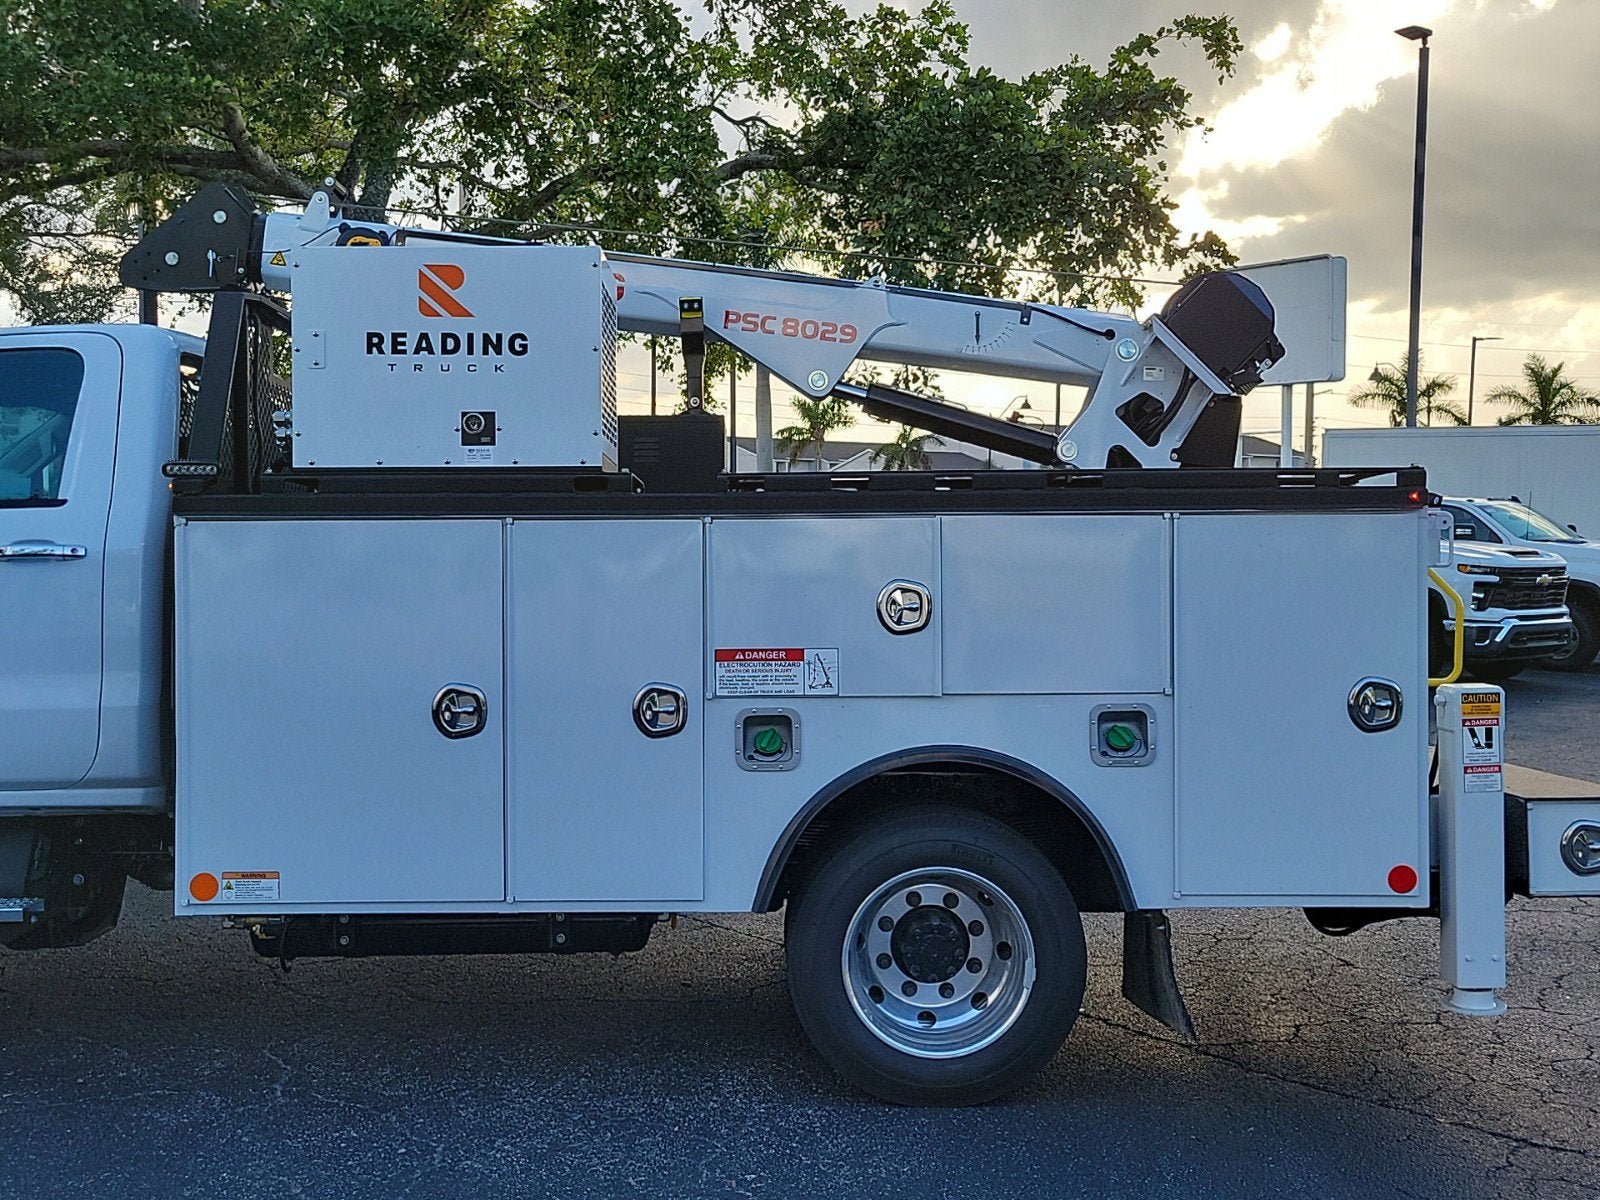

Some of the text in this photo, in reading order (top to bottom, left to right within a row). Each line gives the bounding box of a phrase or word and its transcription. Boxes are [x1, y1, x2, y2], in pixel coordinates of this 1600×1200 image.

[723, 310, 857, 344] PSC 8029
[366, 332, 529, 357] READING
[387, 363, 505, 373] TRUCK
[746, 651, 786, 660] DANGER
[1462, 693, 1499, 703] CAUTION
